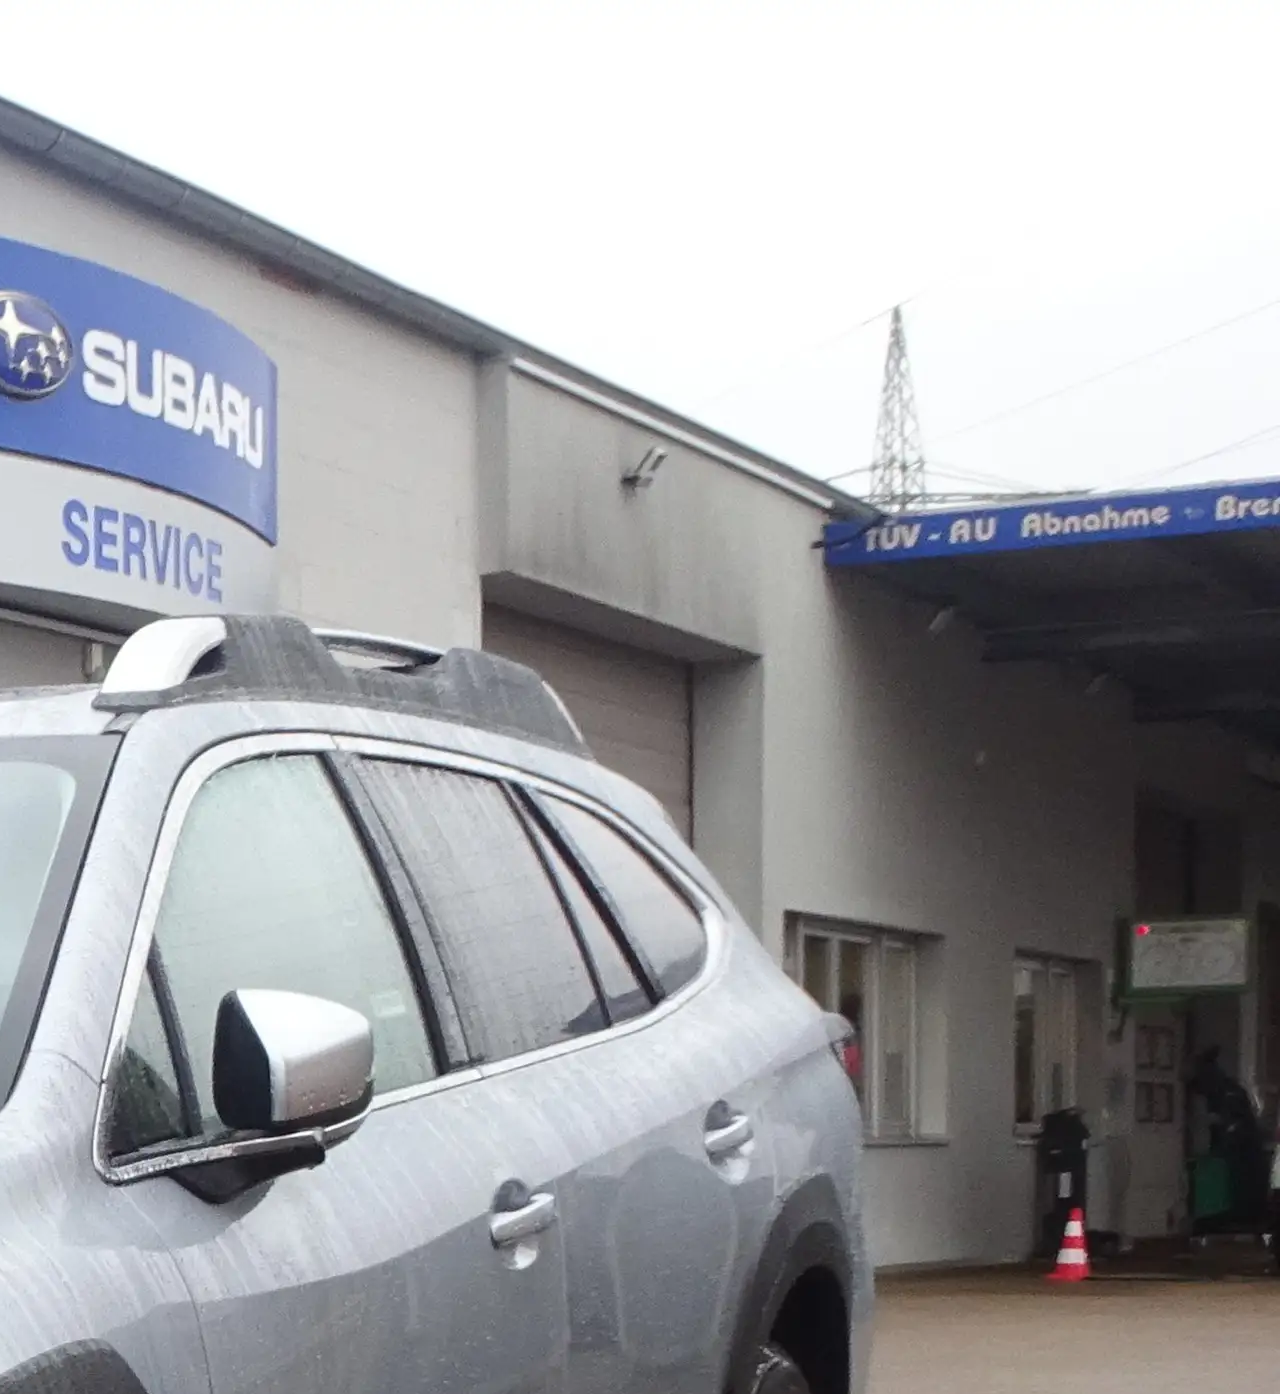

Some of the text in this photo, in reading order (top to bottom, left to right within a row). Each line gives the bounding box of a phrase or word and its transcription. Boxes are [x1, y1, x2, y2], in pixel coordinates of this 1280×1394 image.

[82, 330, 263, 470] SUBARU
[61, 499, 222, 602] SERVICE
[949, 517, 998, 544] AU
[1020, 505, 1171, 538] Abnahme
